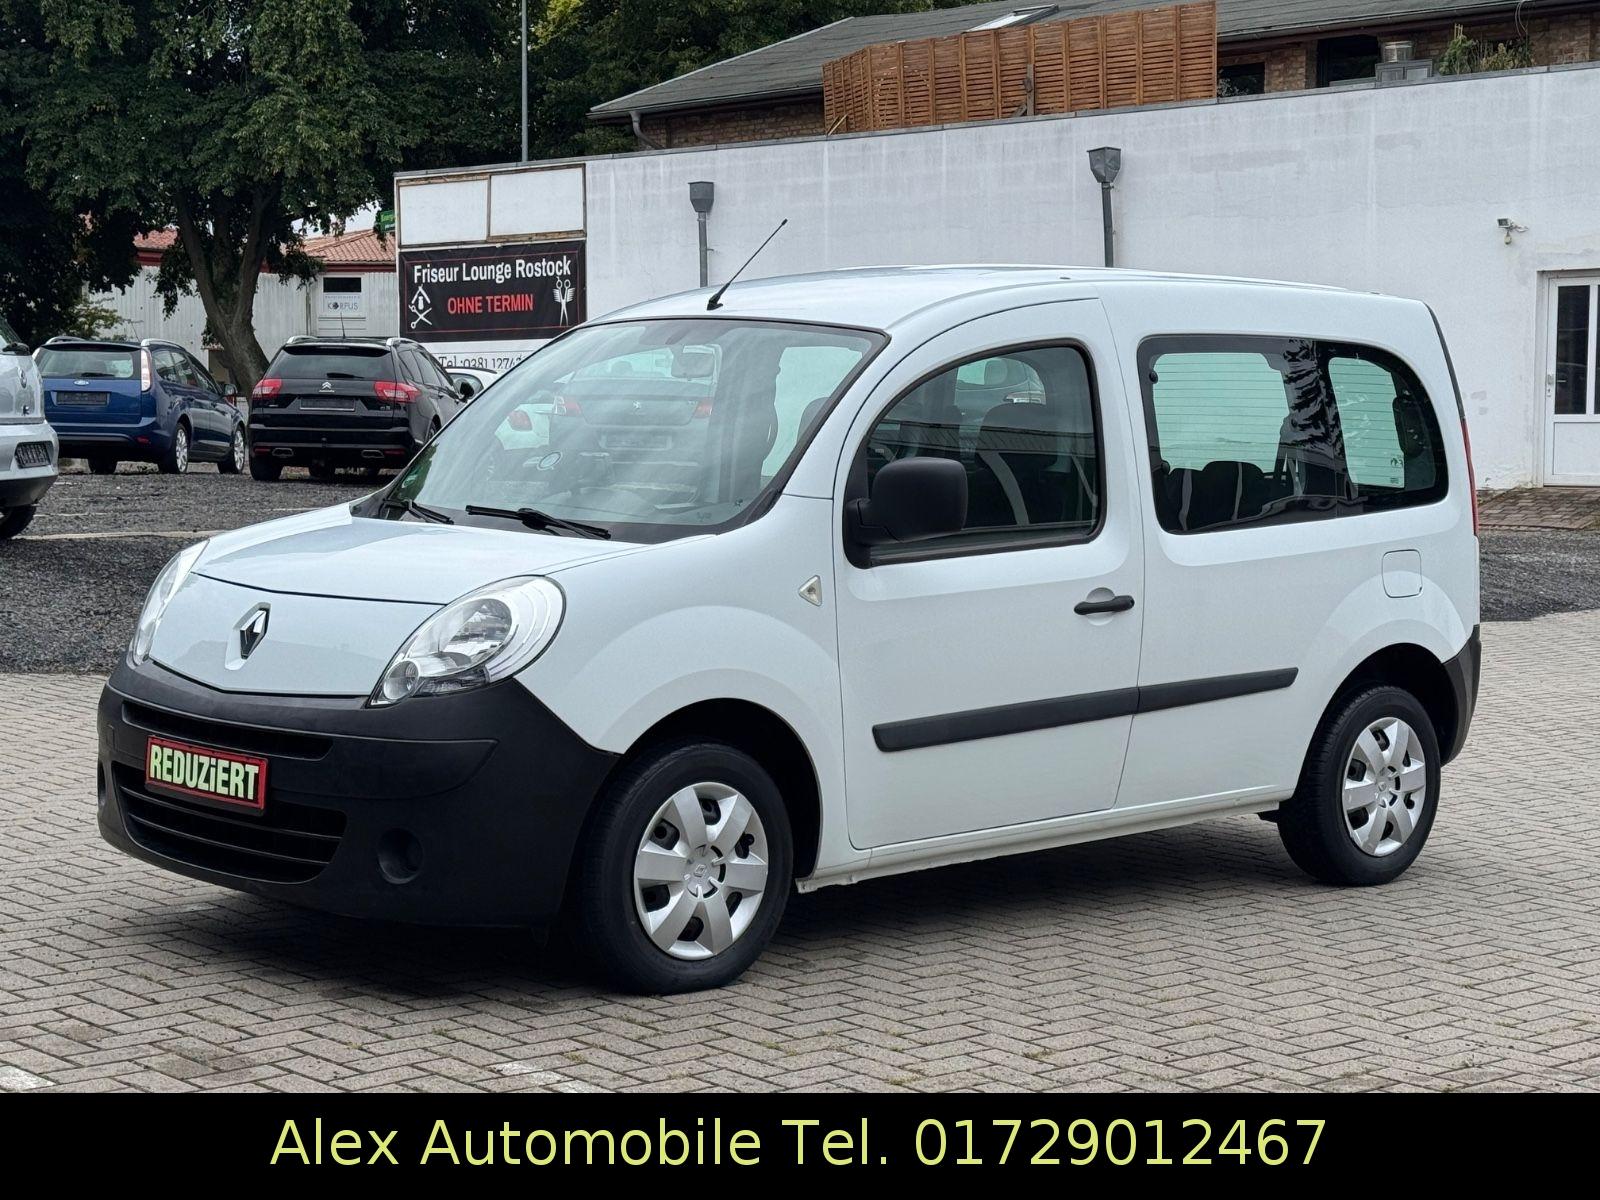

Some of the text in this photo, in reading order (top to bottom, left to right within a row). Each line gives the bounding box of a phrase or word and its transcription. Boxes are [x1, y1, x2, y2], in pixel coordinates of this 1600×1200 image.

[413, 255, 572, 284] Friseur Lounge Rostock
[447, 294, 534, 315] OHNE TERMIN
